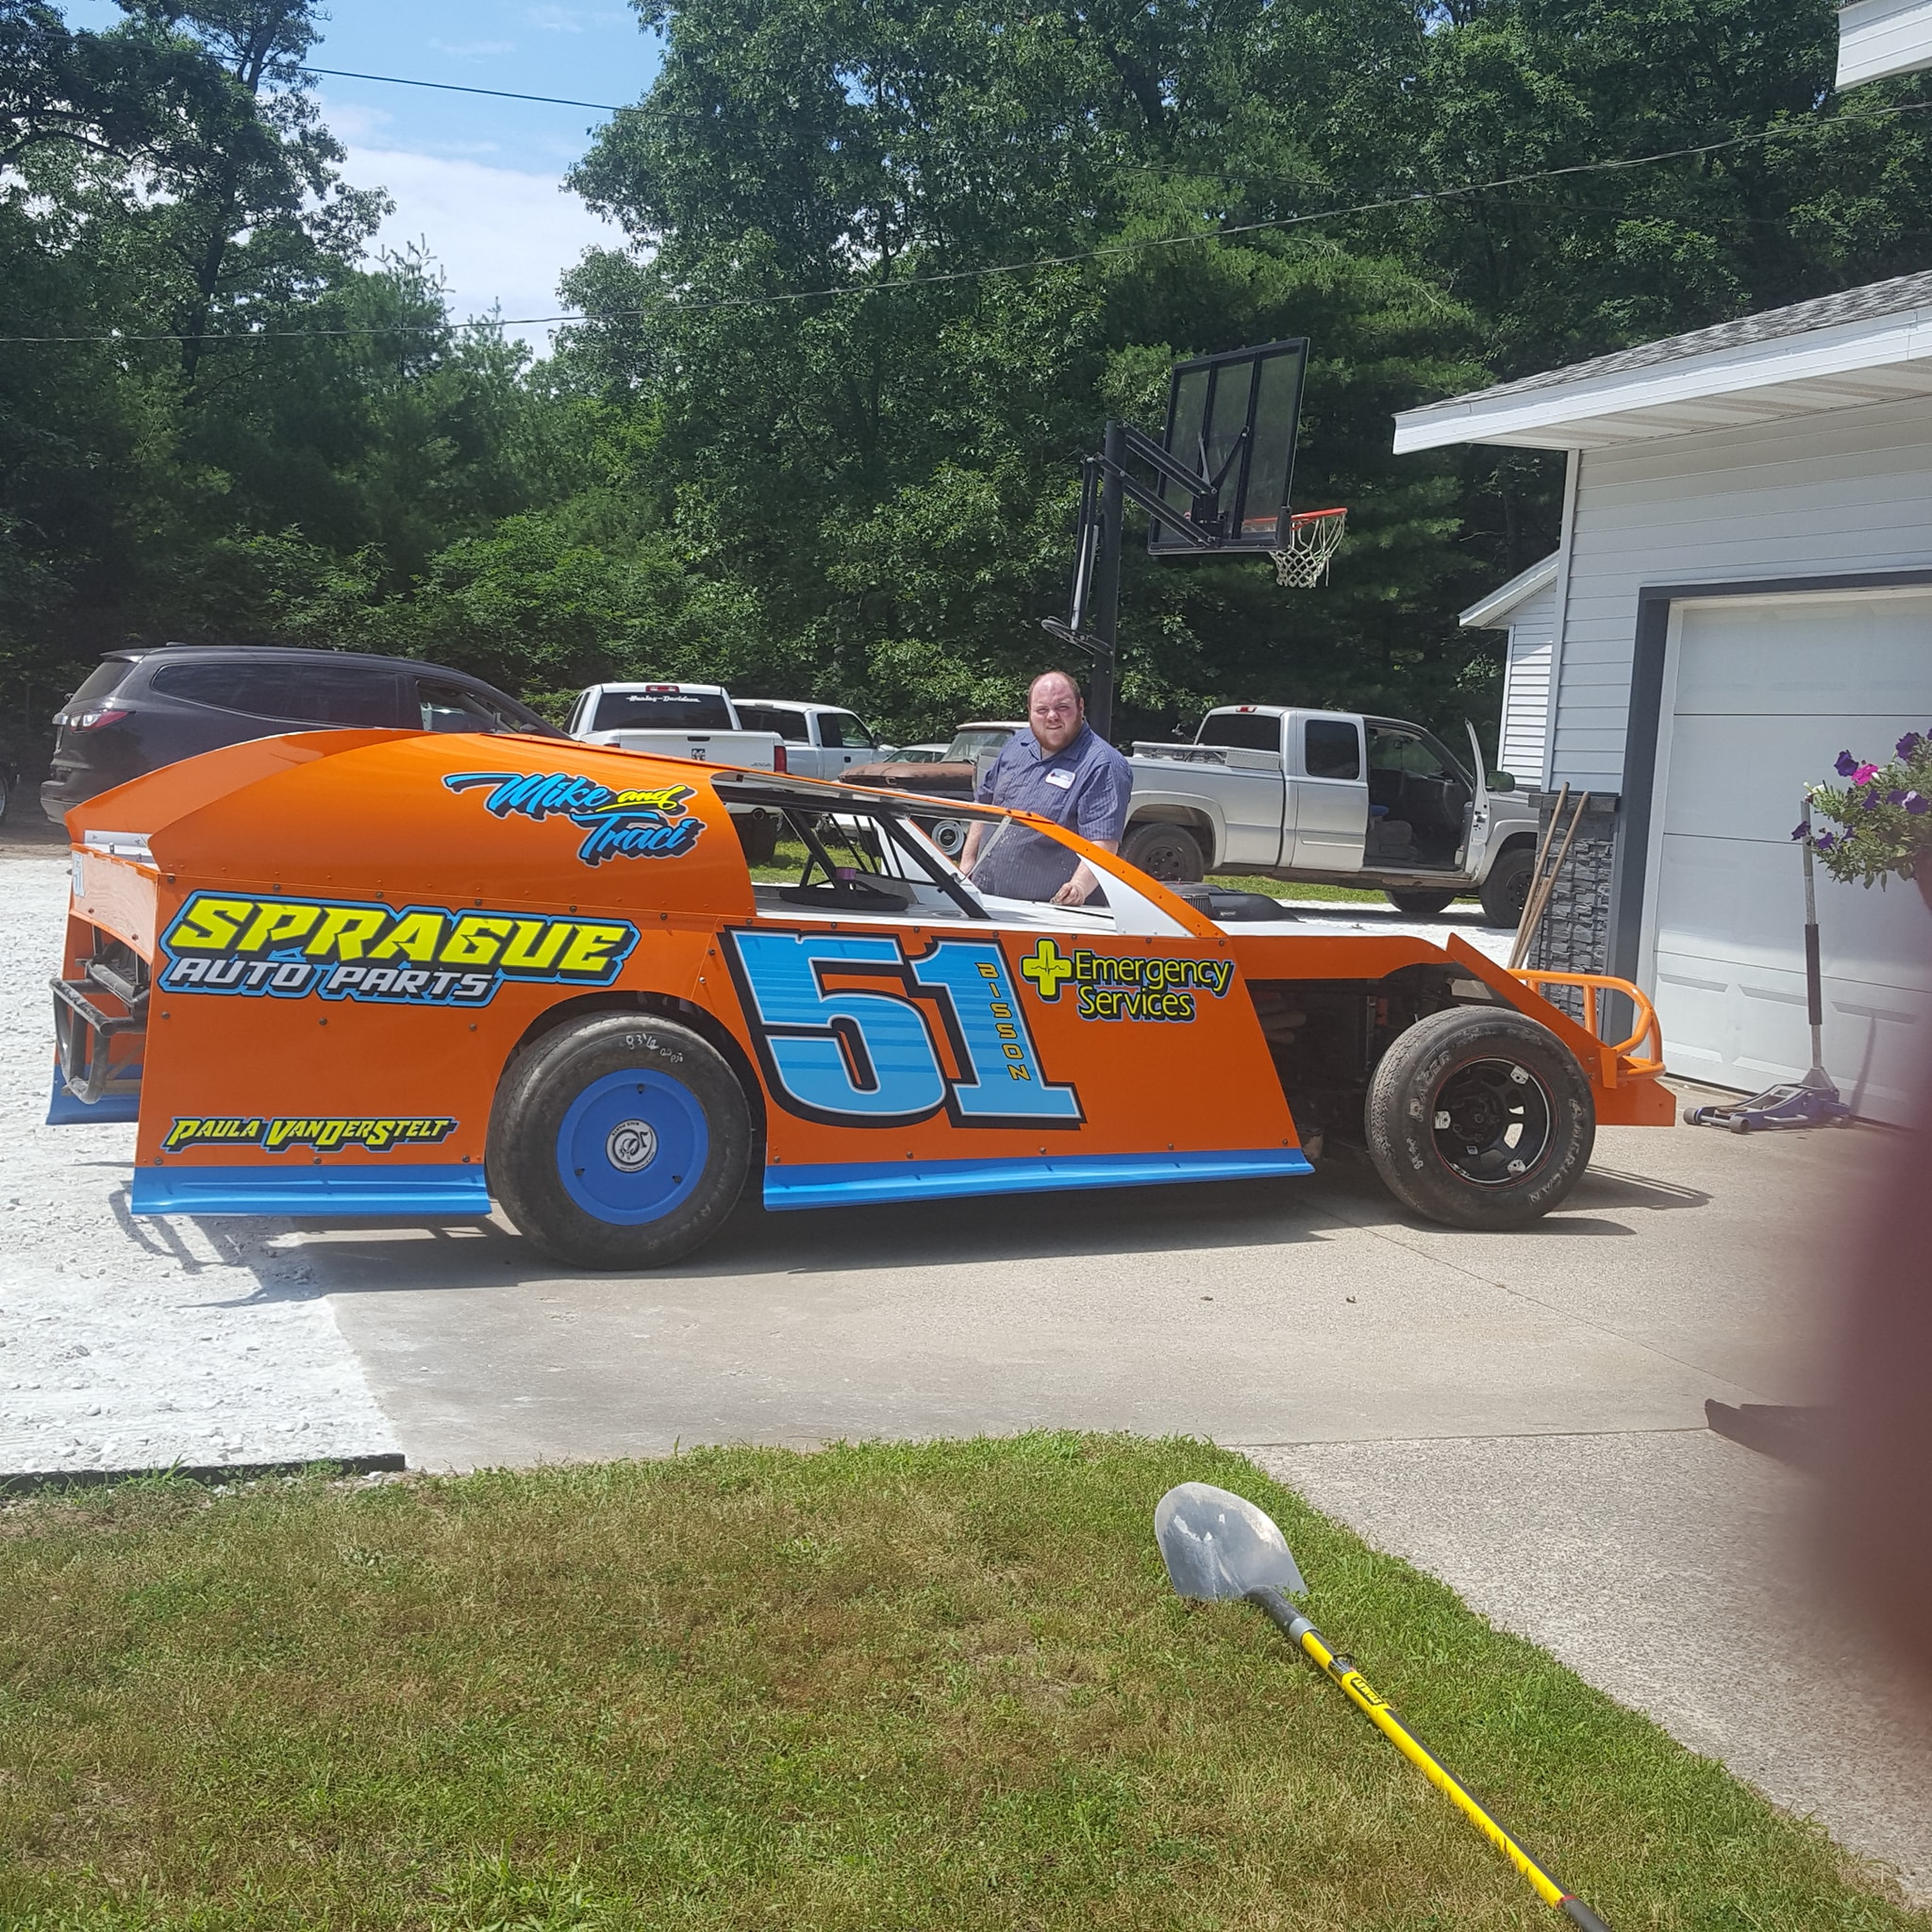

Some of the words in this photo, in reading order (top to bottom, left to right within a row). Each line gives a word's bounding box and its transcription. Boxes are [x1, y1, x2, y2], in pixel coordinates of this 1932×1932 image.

[444, 773, 611, 813] Mike
[595, 785, 687, 811] and
[570, 811, 698, 859] Traci
[170, 897, 629, 972] SPRAGUE
[168, 958, 311, 988] AUTO
[327, 966, 495, 996] PARTS
[1074, 951, 1230, 992] Emergency
[974, 961, 1032, 1082] BISSON
[1079, 986, 1192, 1016] Services
[727, 928, 1084, 1123] 51
